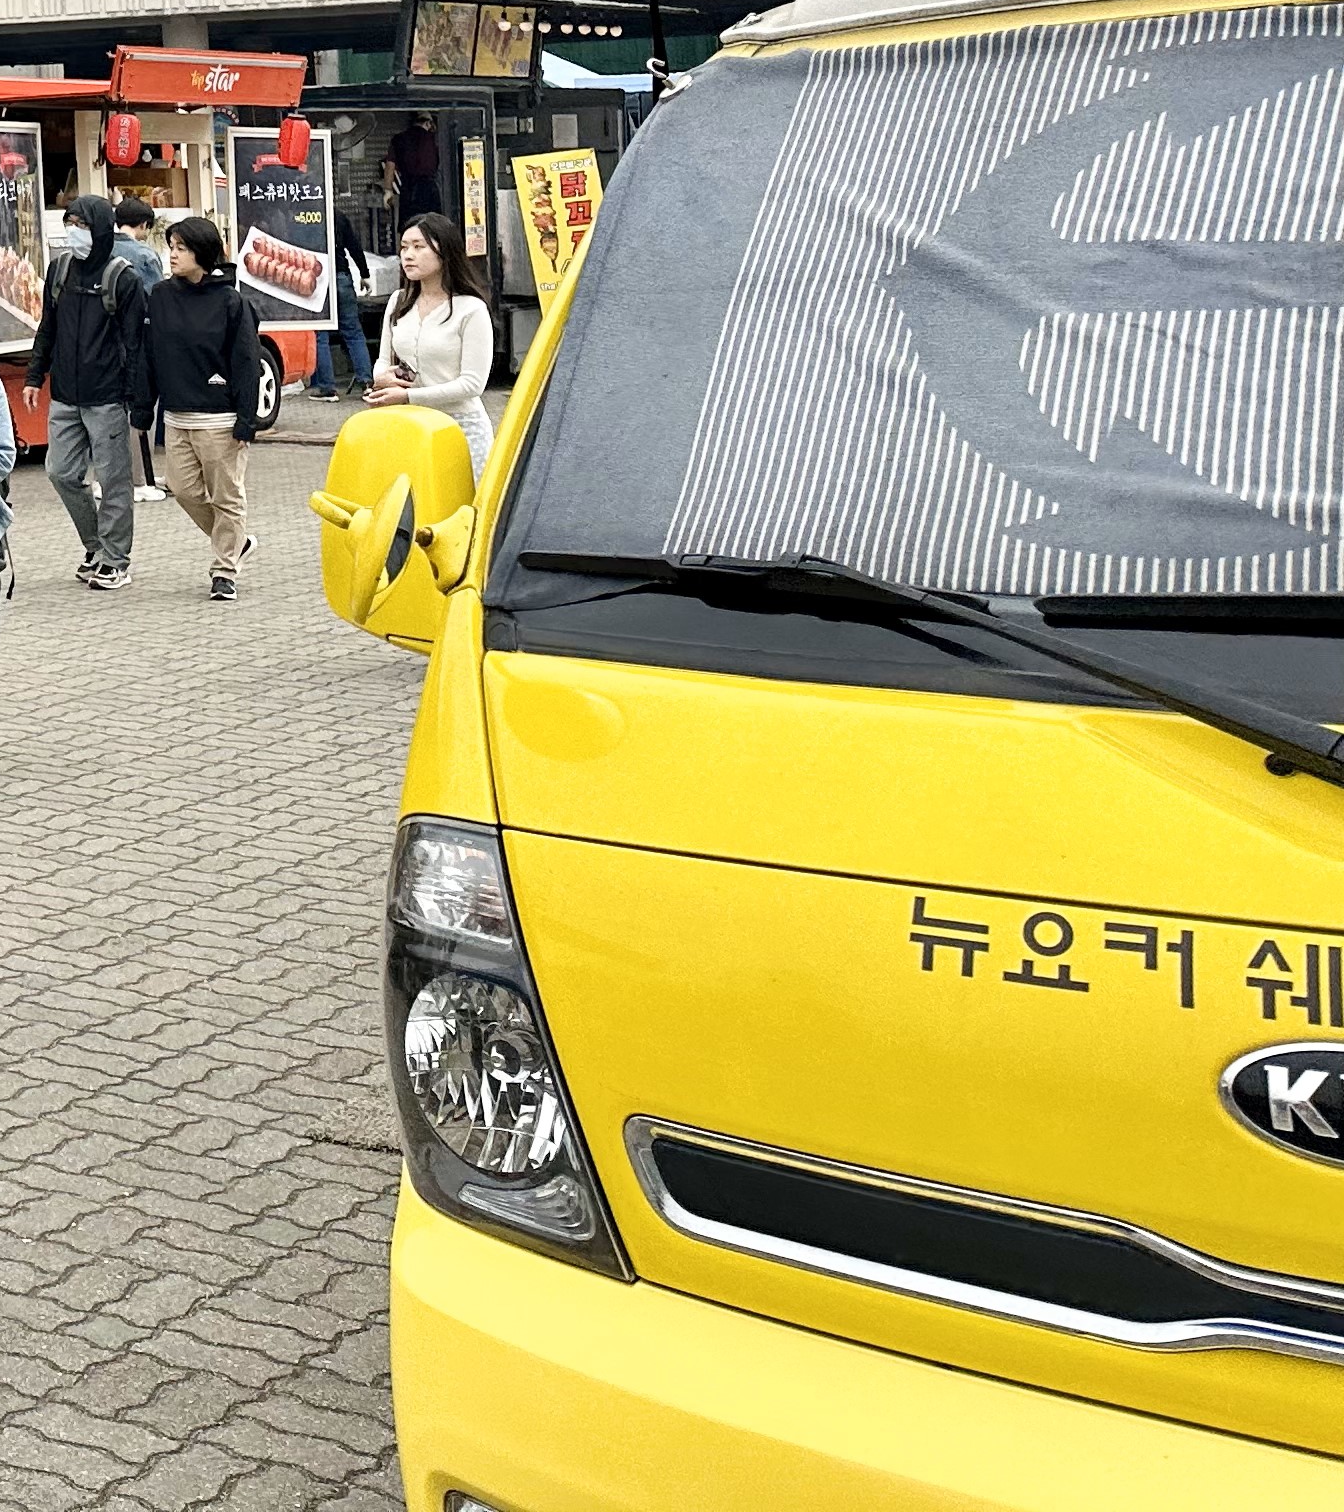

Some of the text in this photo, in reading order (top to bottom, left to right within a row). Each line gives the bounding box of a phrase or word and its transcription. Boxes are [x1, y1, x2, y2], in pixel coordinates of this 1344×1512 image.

[204, 64, 240, 92] star
[910, 896, 1196, 1009] 뉴요커
[1264, 1063, 1344, 1140] K
